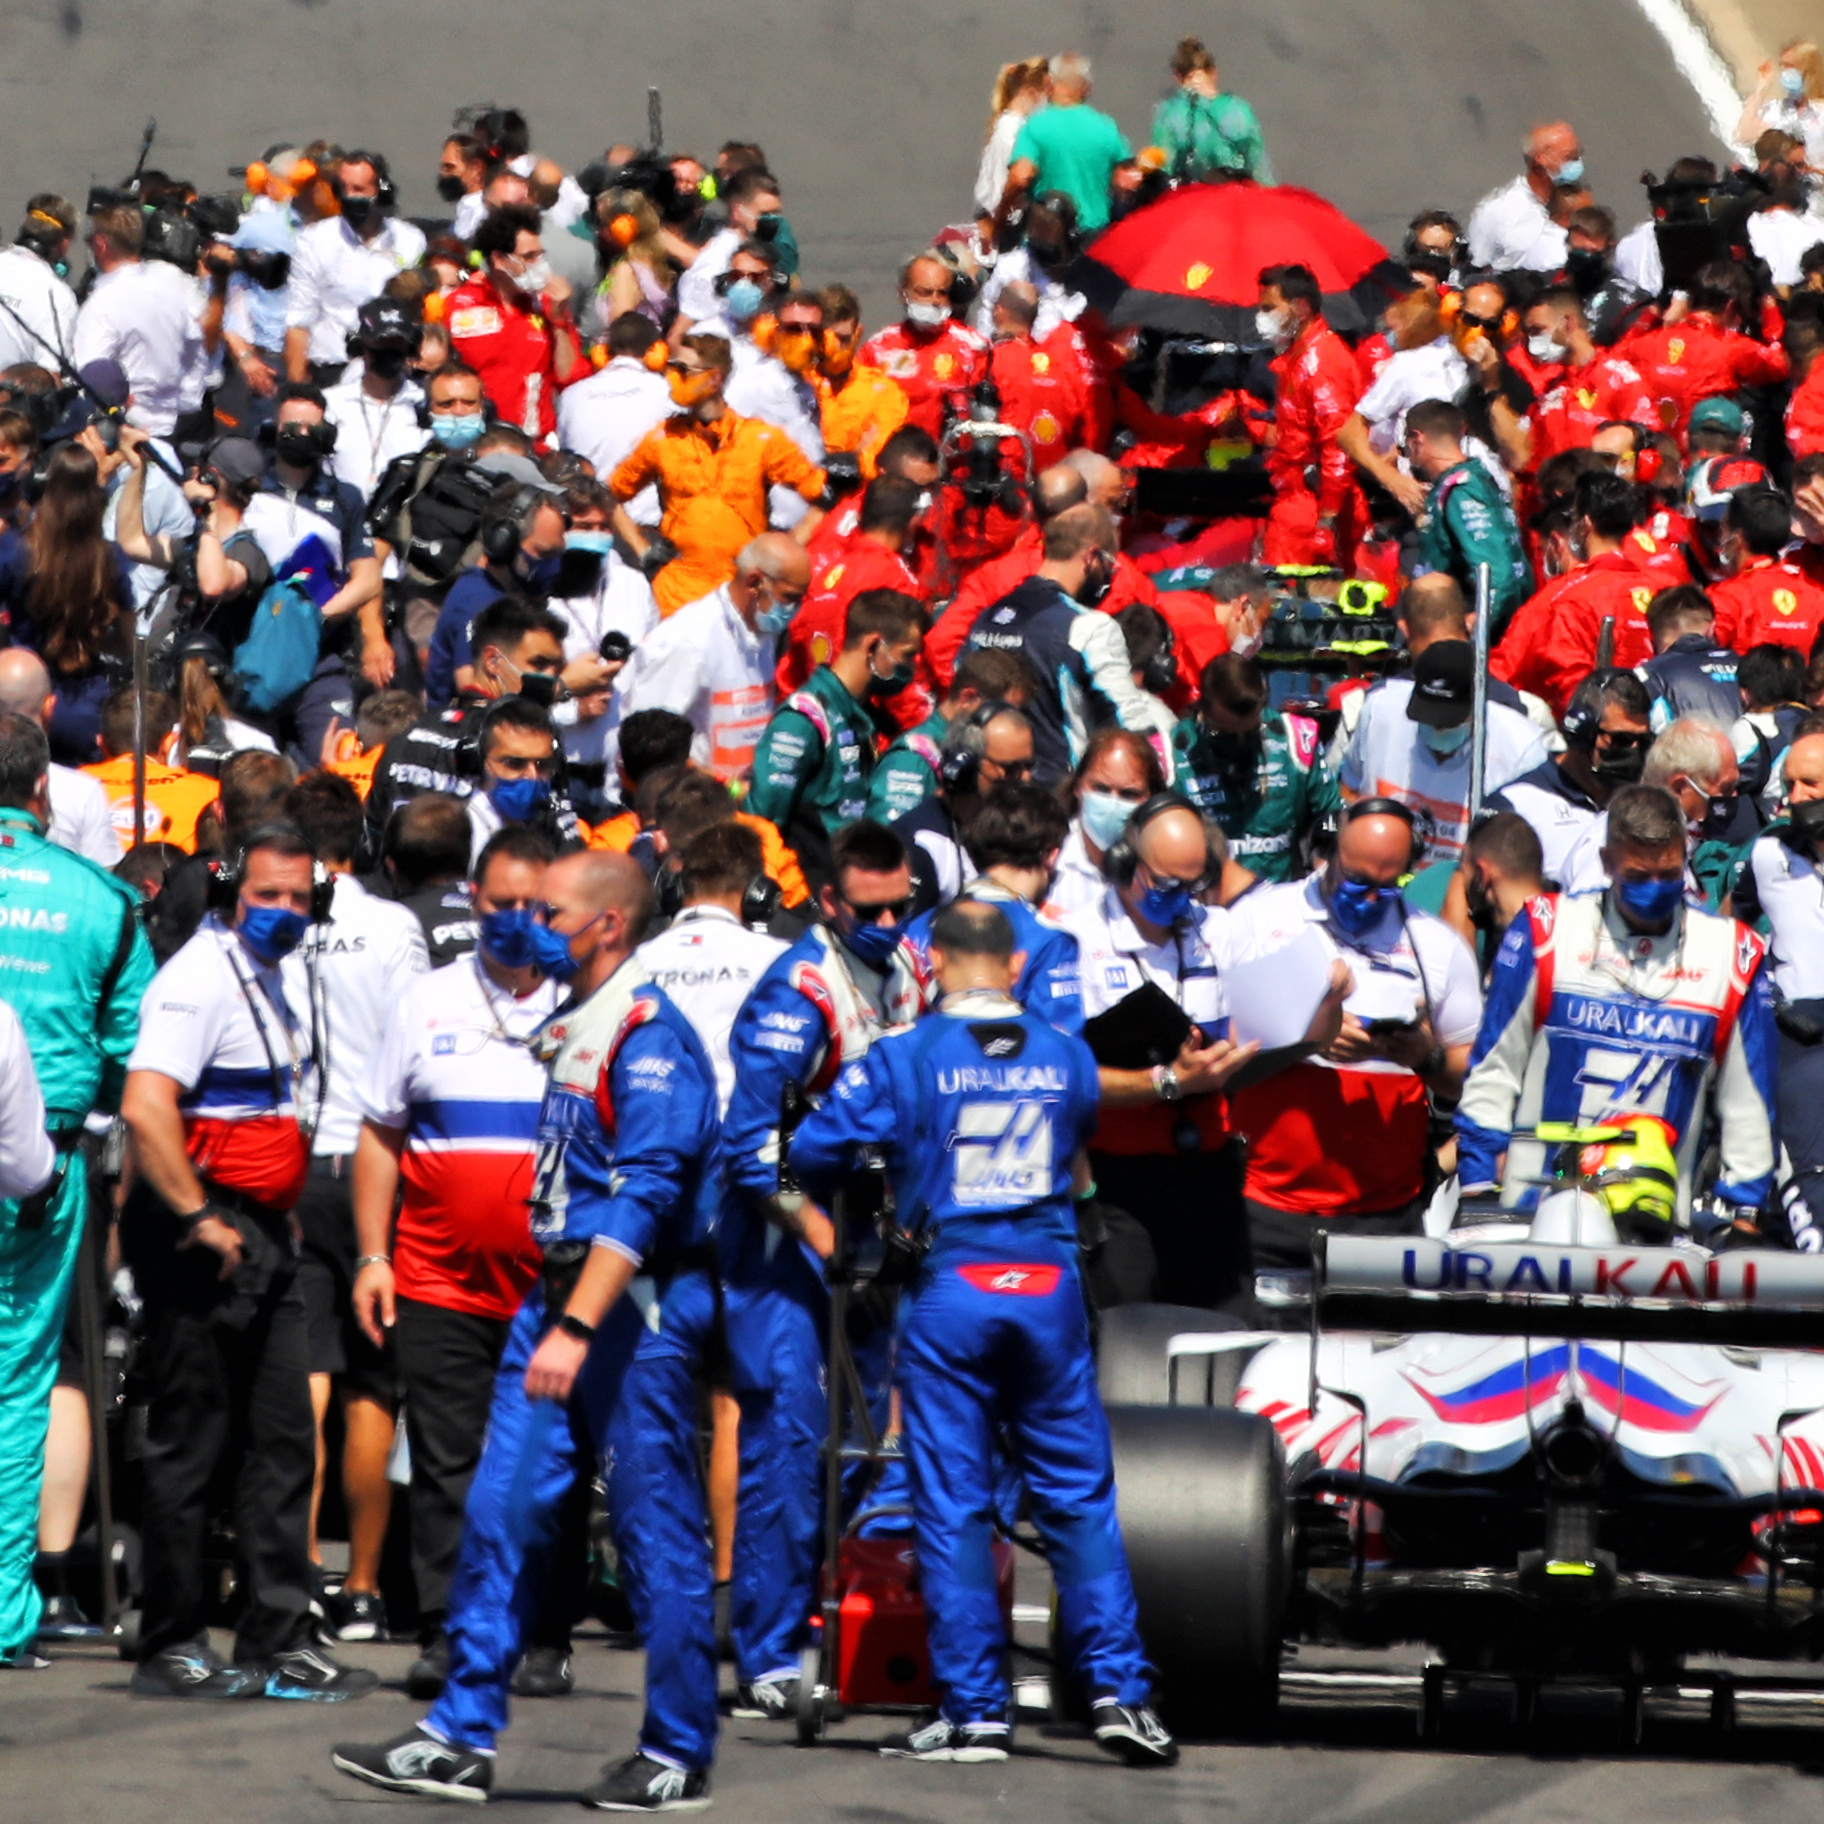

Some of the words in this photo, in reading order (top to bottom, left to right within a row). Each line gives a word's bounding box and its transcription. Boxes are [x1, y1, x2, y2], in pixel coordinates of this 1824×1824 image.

[649, 966, 752, 987] TRONAS
[1565, 998, 1699, 1047] URALKALI
[937, 1064, 1067, 1095] URALKALI
[1401, 1248, 1759, 1302] URALKALI
